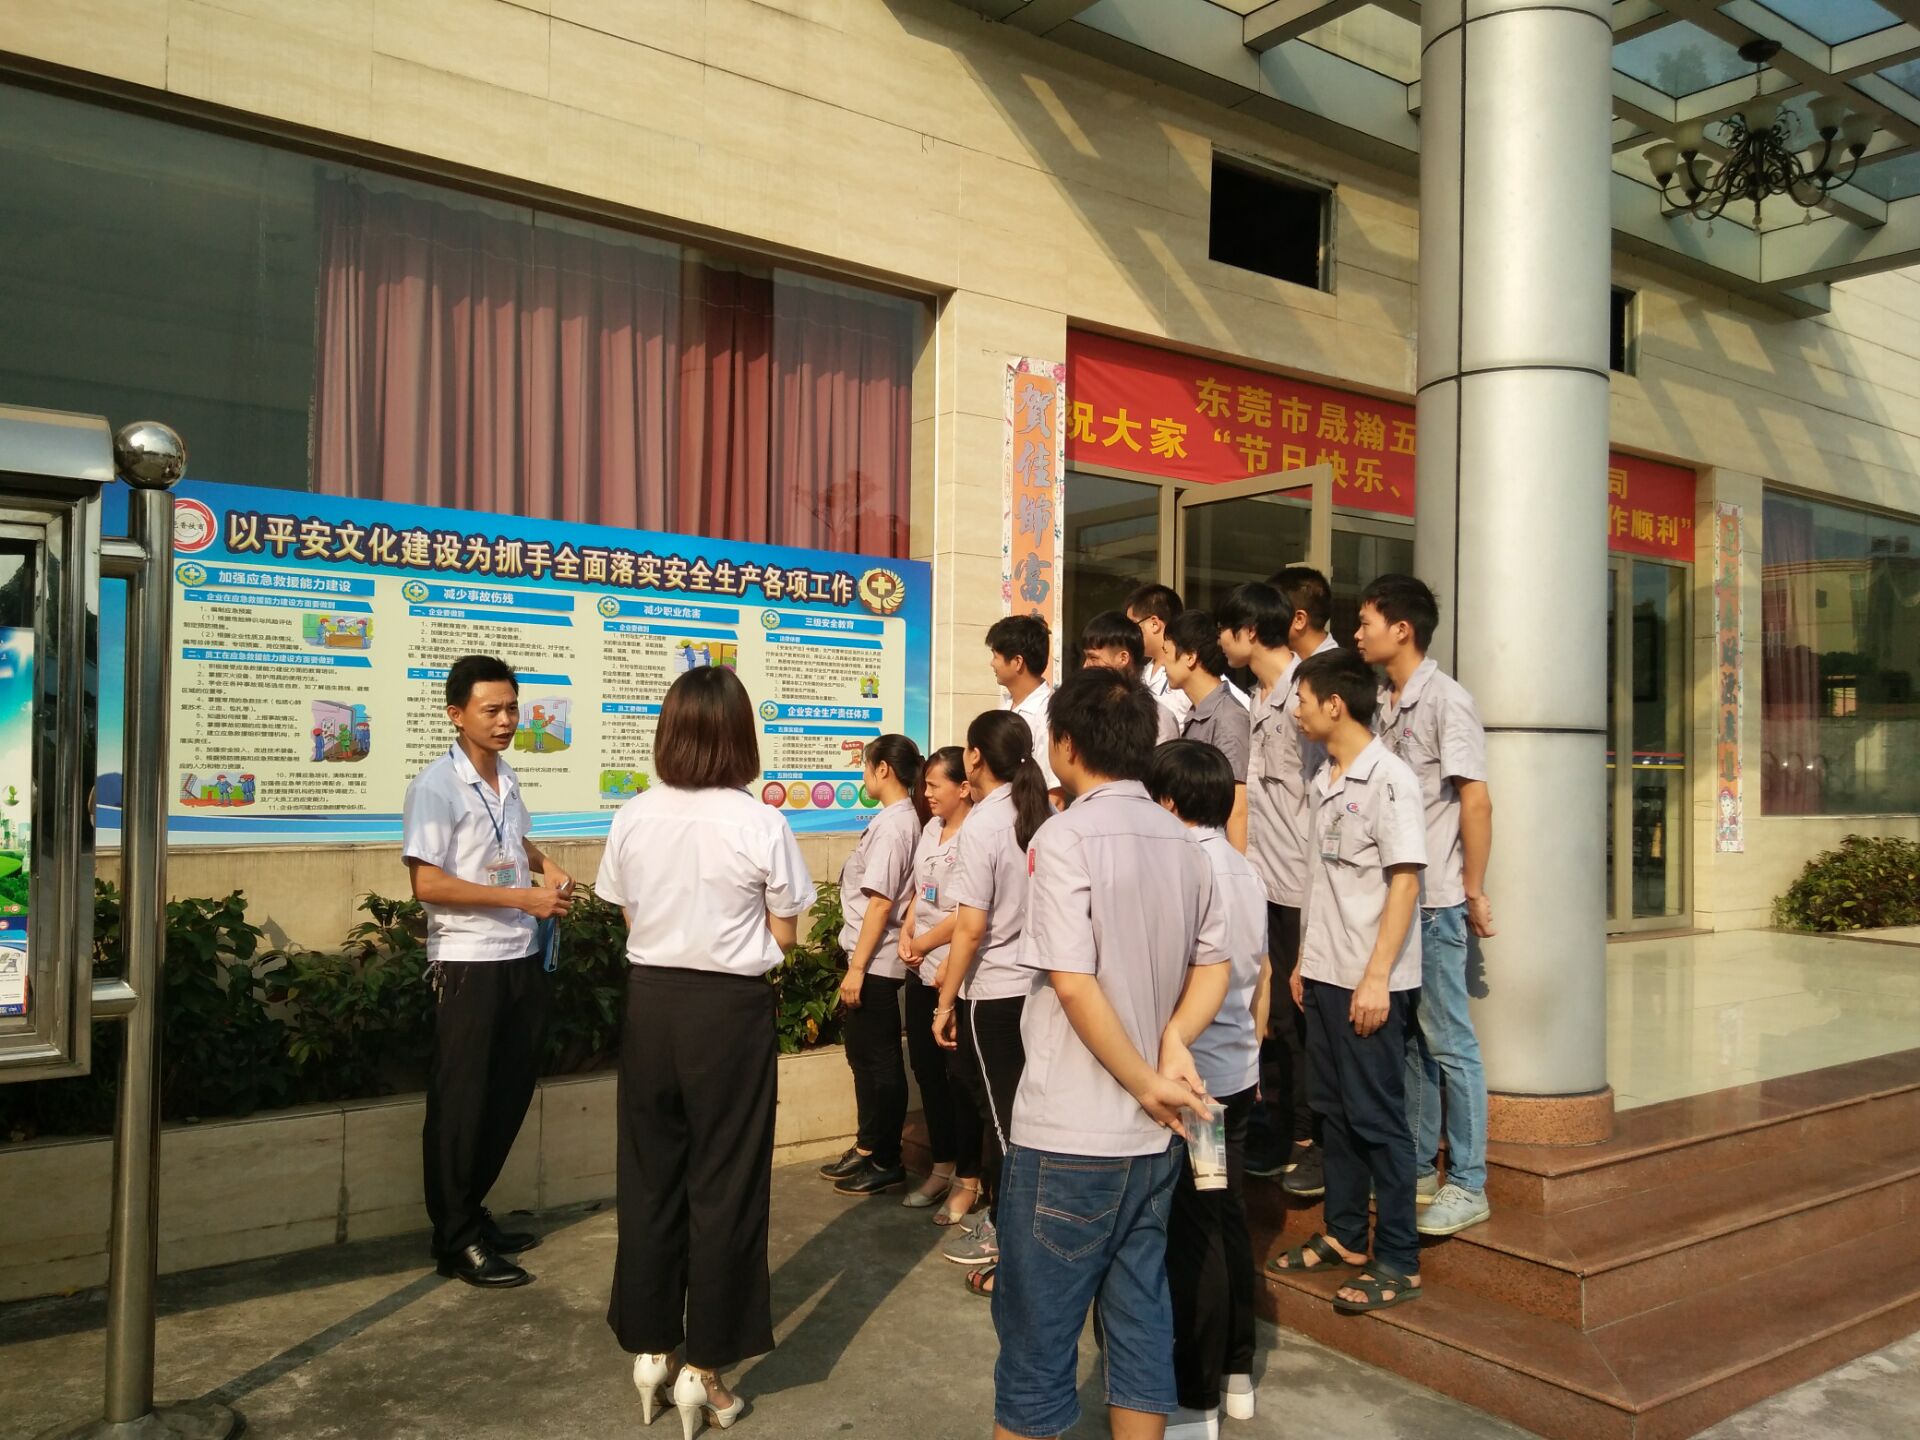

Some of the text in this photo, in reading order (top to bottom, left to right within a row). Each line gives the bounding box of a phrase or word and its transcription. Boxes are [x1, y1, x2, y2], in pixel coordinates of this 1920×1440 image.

[1195, 377, 1416, 455] 东莞市晟瀚五
[229, 514, 853, 604] 以平安文化建设为抓手全面落实安全生产各项工作
[219, 571, 351, 592] 加强应急救援能力建设
[444, 588, 514, 604] 减少事故伤残
[644, 605, 701, 619] 减少职业危害
[805, 617, 854, 630] 三级安全教育
[788, 706, 870, 719] 企业安全生产责任体系
